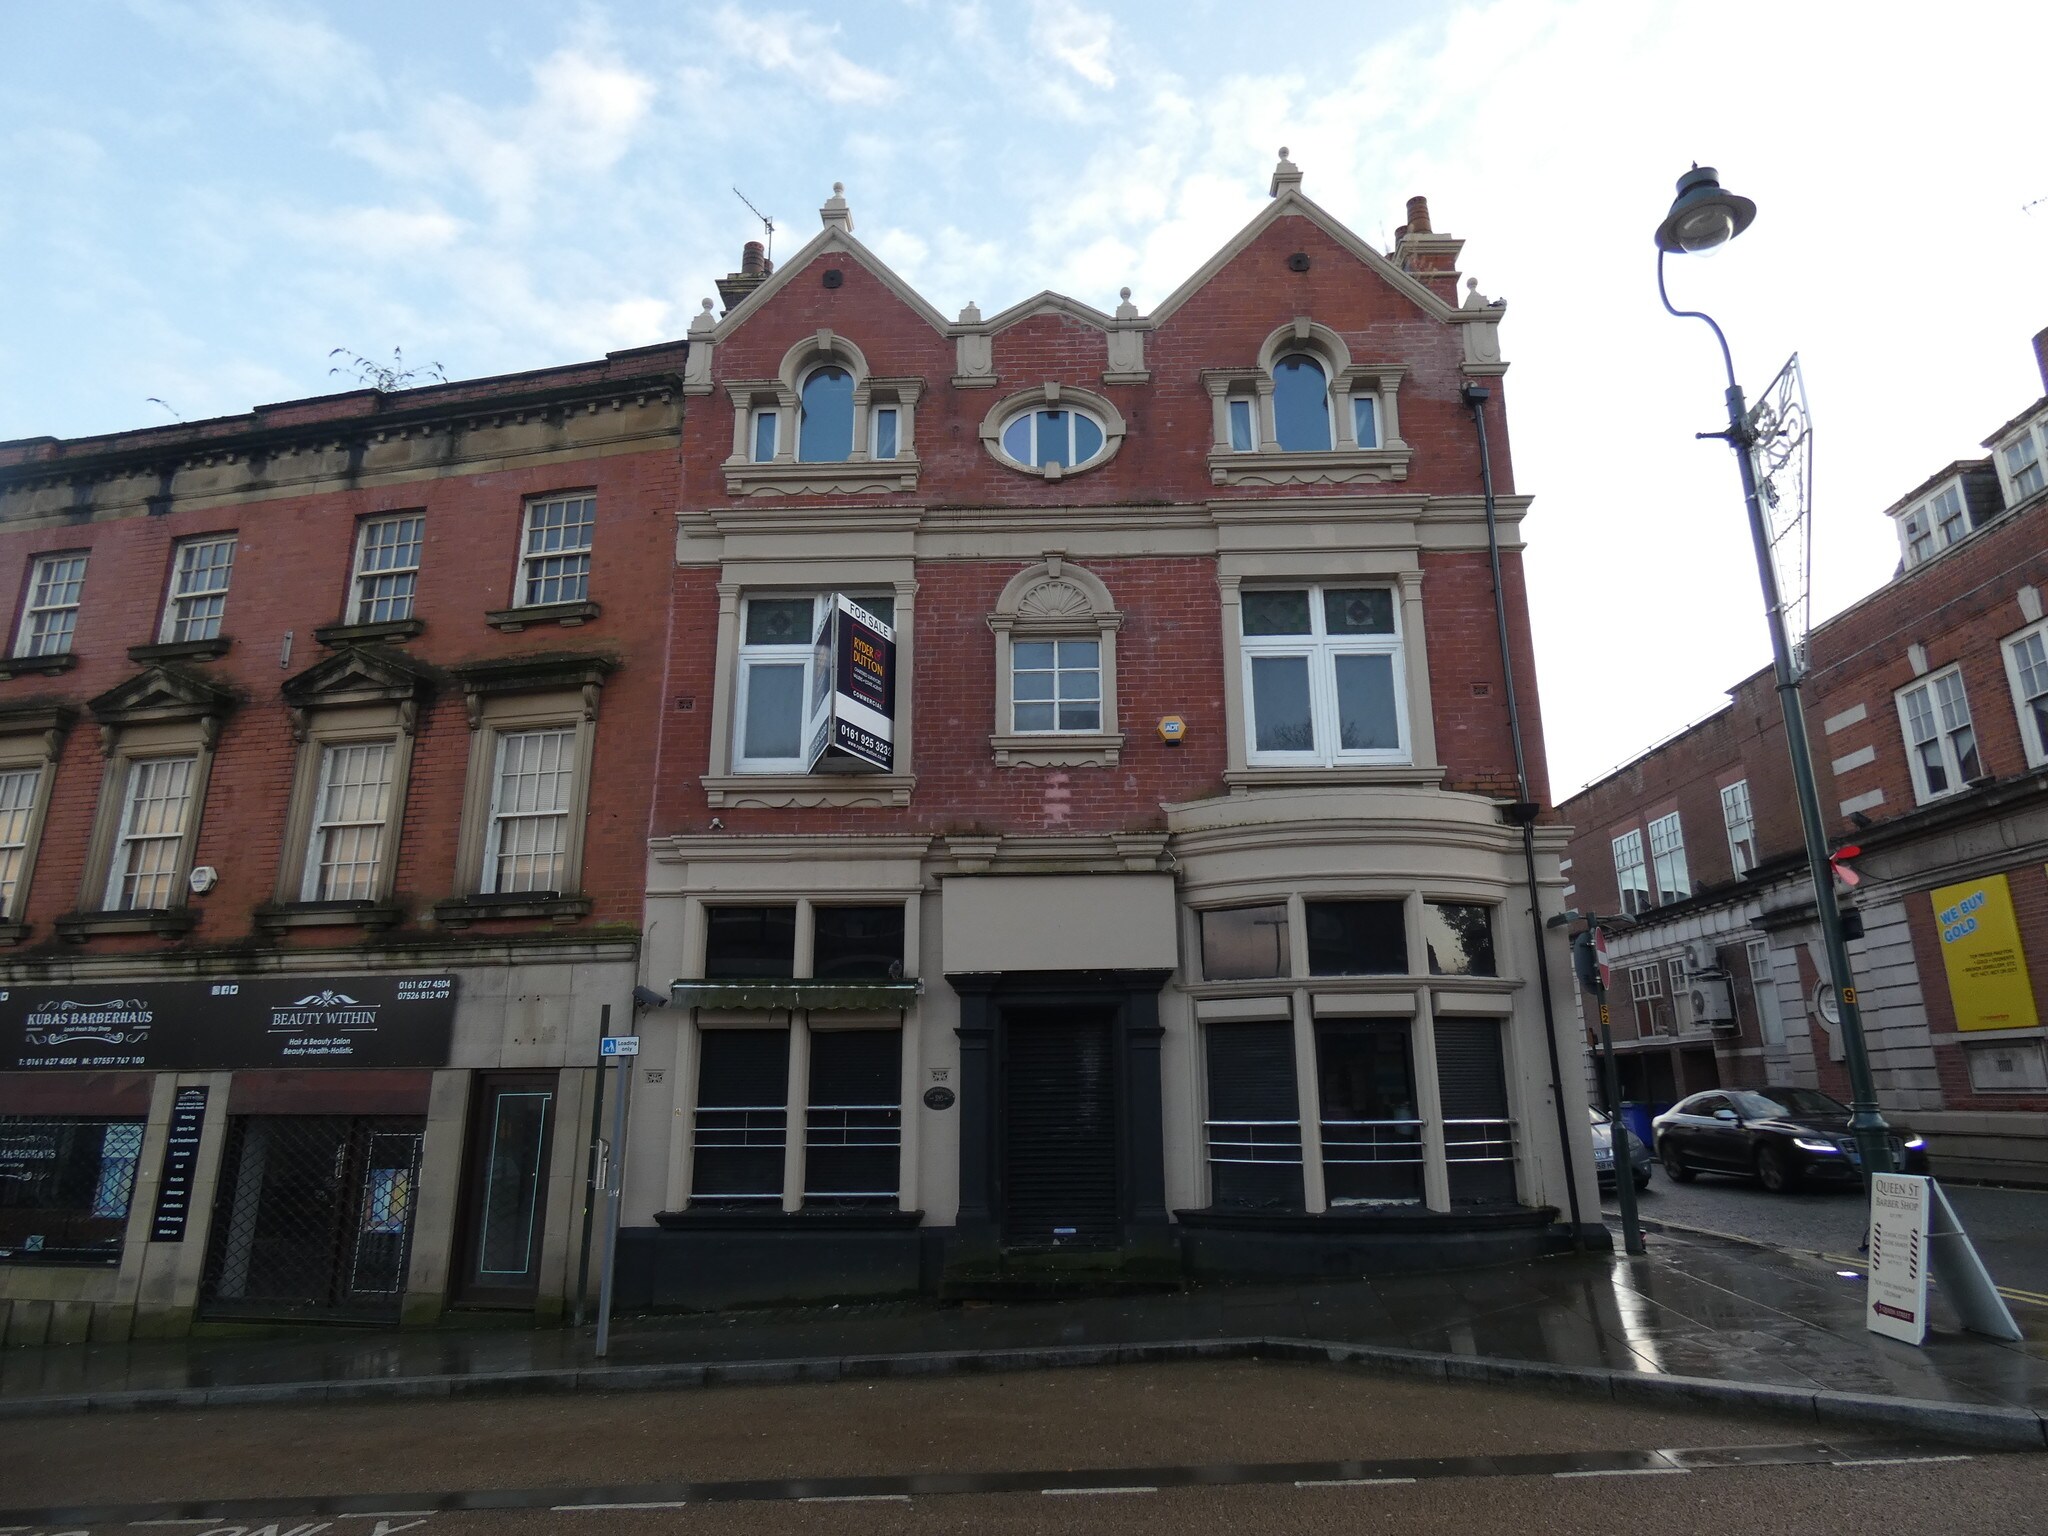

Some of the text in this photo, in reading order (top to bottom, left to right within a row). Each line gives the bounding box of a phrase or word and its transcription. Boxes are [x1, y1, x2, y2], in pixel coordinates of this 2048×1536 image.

[850, 603, 866, 623] FOR
[869, 616, 889, 638] SALE
[853, 637, 874, 659] RYDER
[853, 650, 883, 676] DUTTON
[853, 690, 883, 711] COMMERCIAL
[841, 724, 859, 742] 0161
[860, 734, 874, 748] 925
[875, 741, 892, 757] 3232
[1940, 891, 1984, 925] WE BUY
[1944, 918, 1976, 942] GOLD
[399, 979, 451, 990] 0161 627 4504
[397, 991, 449, 1000] 07526 812 479
[1845, 989, 1853, 1001] 9
[1601, 1005, 1608, 1014] S
[27, 1011, 153, 1026] KUBAS BARBERHAUS
[272, 1011, 376, 1026] BEAUTY WITHIN
[1602, 1014, 1609, 1024] 2
[289, 1037, 351, 1047] Hair & Beauty Salon
[26, 1058, 43, 1066] 0161
[45, 1057, 59, 1066] 627
[60, 1057, 77, 1065] 4504
[93, 1056, 115, 1065] 07557
[116, 1056, 130, 1064] 767
[132, 1056, 145, 1065] 100
[1876, 1180, 1919, 1197] QUEEN ST
[1876, 1197, 1918, 1211] BARBER SHOP
